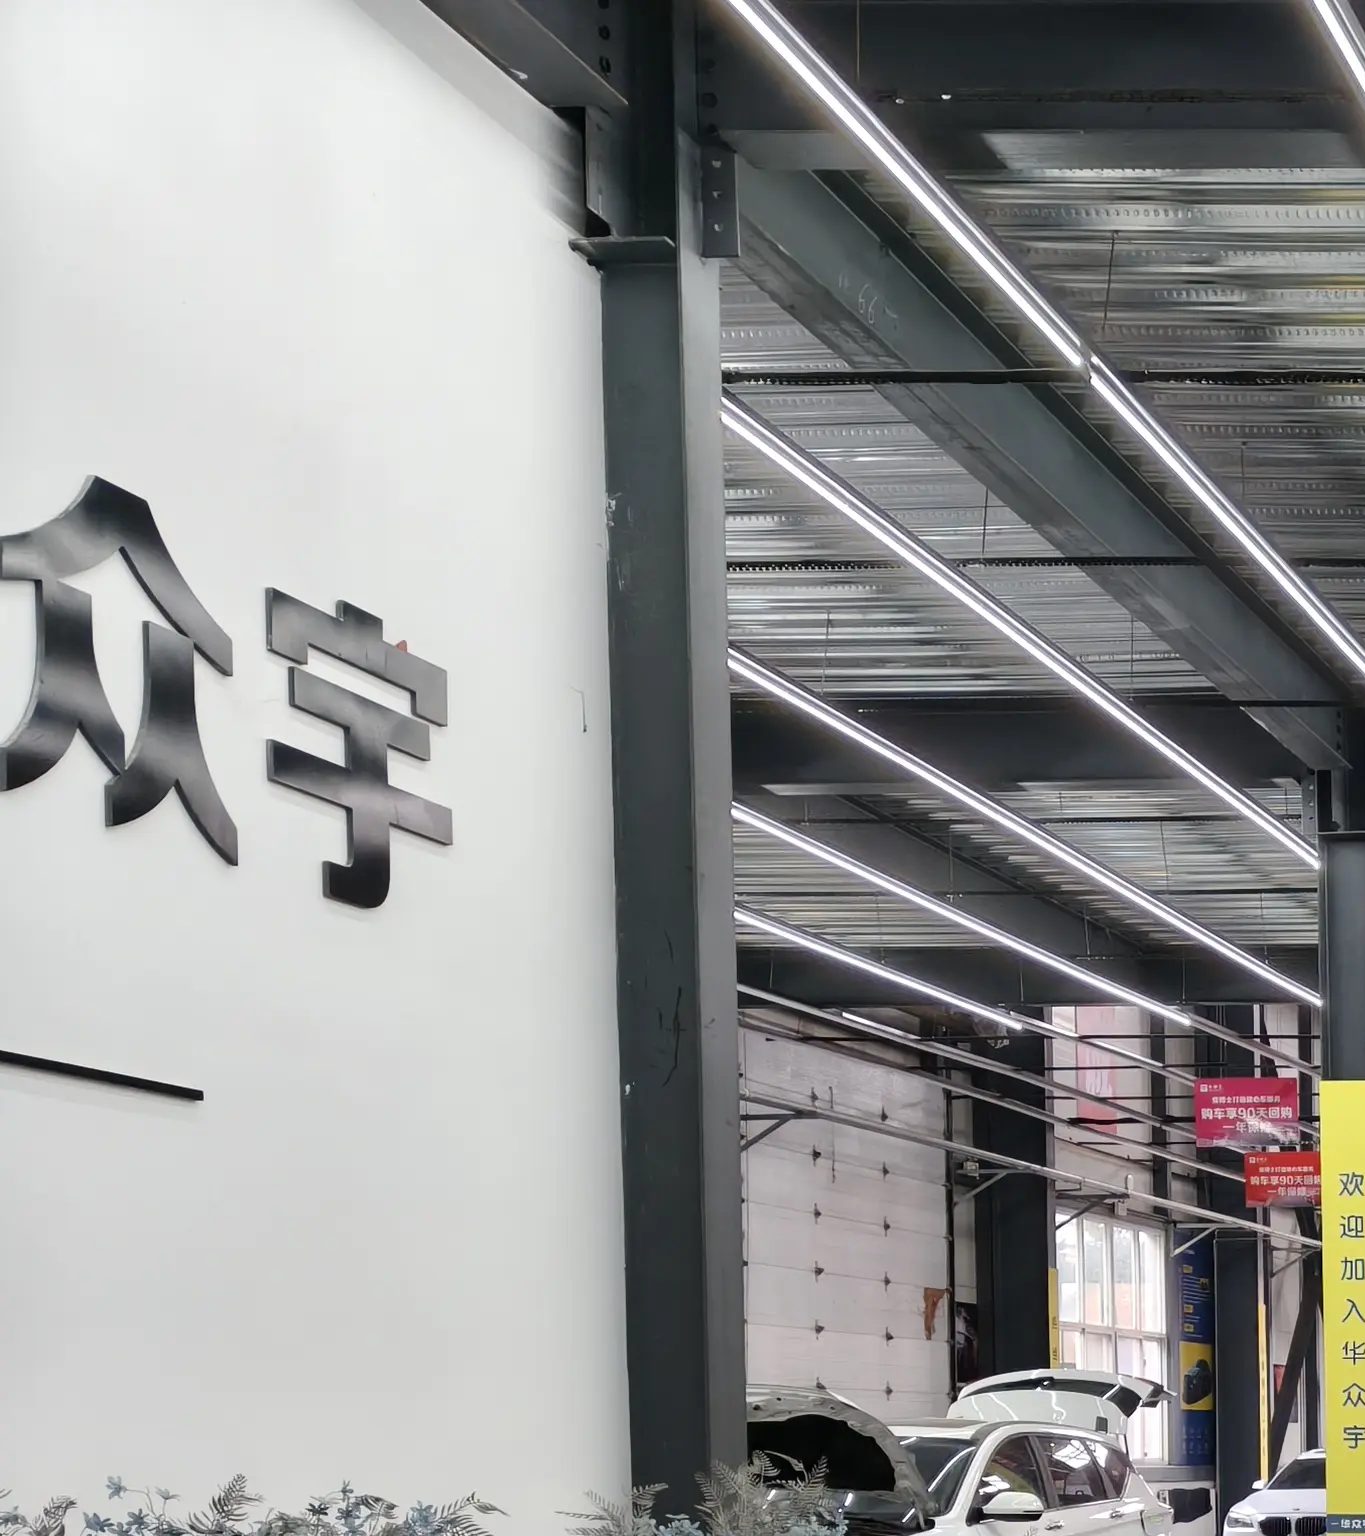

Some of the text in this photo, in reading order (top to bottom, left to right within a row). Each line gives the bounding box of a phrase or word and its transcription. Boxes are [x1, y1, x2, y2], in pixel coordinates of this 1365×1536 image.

[0, 475, 453, 909] 众宇
[1201, 1107, 1292, 1120] 购车享90天回购
